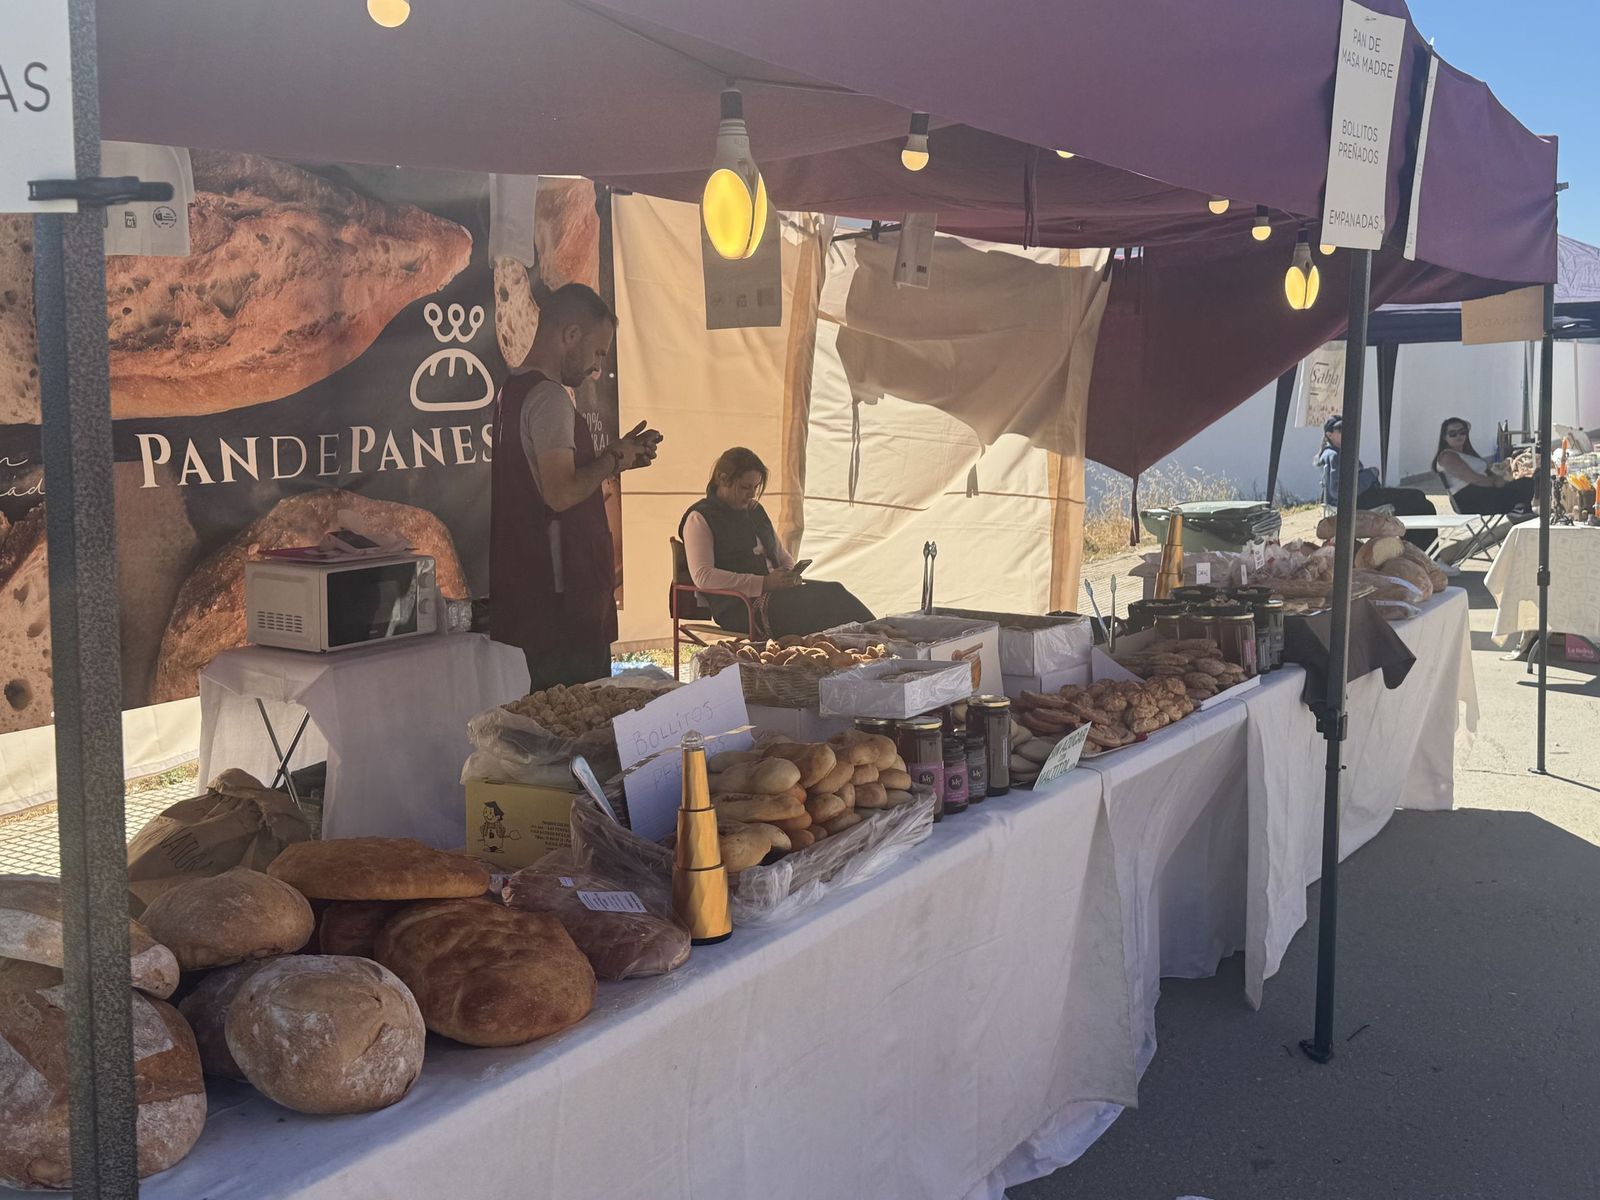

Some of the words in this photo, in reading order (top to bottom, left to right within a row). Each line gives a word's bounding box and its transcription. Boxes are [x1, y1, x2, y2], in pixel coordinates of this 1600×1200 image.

[1353, 28, 1367, 48] PAN
[1368, 35, 1381, 53] DE
[1342, 48, 1360, 69] MASA
[1362, 56, 1394, 79] MADRE
[1342, 119, 1378, 142] BOLLITOS
[1338, 142, 1379, 165] PREÑADOS
[1329, 209, 1379, 230] EMPANADAS
